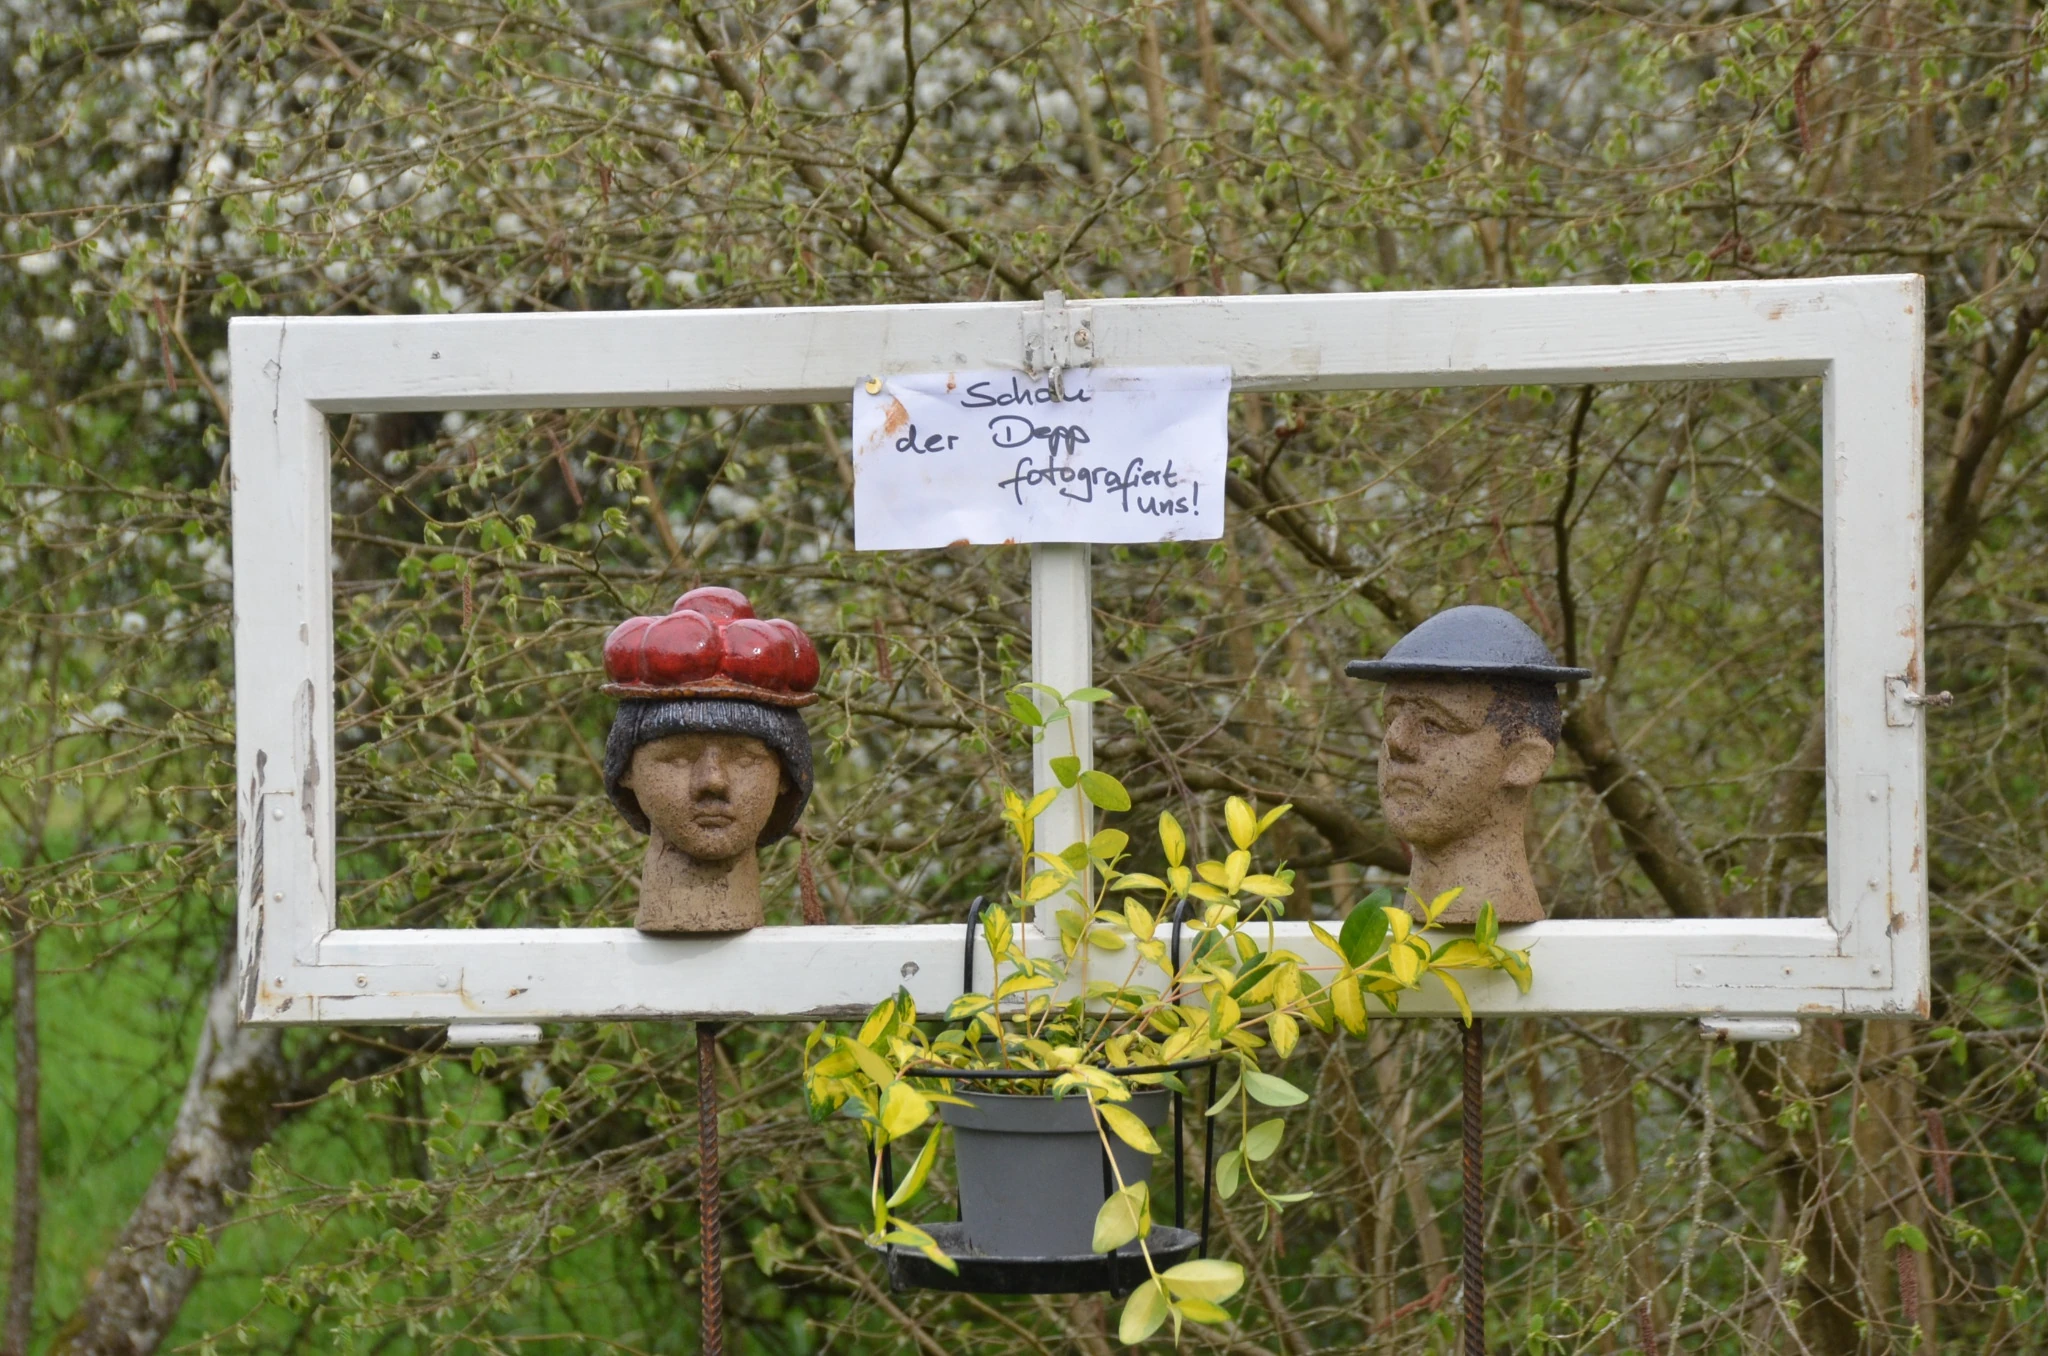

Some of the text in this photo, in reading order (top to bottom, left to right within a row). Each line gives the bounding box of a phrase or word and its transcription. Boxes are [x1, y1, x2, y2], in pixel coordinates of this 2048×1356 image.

[895, 414, 1090, 456] der Depp
[998, 455, 1178, 512] fotografiert
